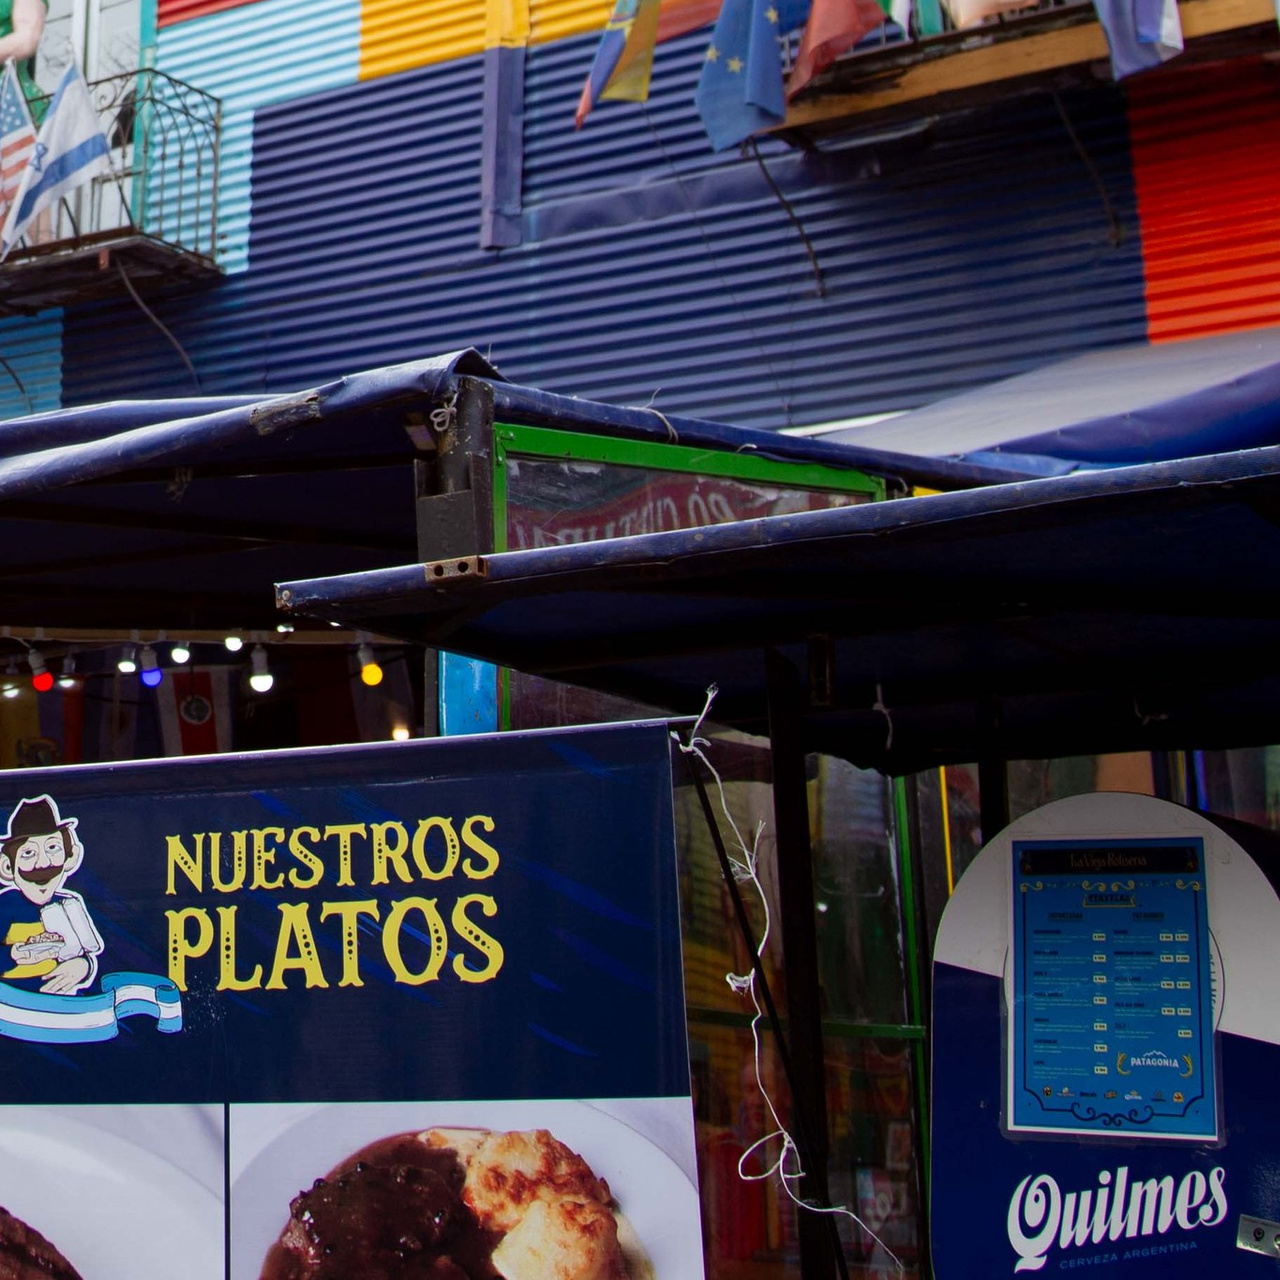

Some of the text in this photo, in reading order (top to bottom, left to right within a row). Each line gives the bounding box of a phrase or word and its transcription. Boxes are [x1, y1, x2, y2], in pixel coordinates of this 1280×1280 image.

[165, 815, 500, 895] NUESTROS
[164, 893, 504, 992] PLATOS
[1130, 1057, 1180, 1068] PATAGONIA
[1007, 1166, 1228, 1274] Quilmes
[1059, 1241, 1198, 1270] CERVEZA ARGENTINA
